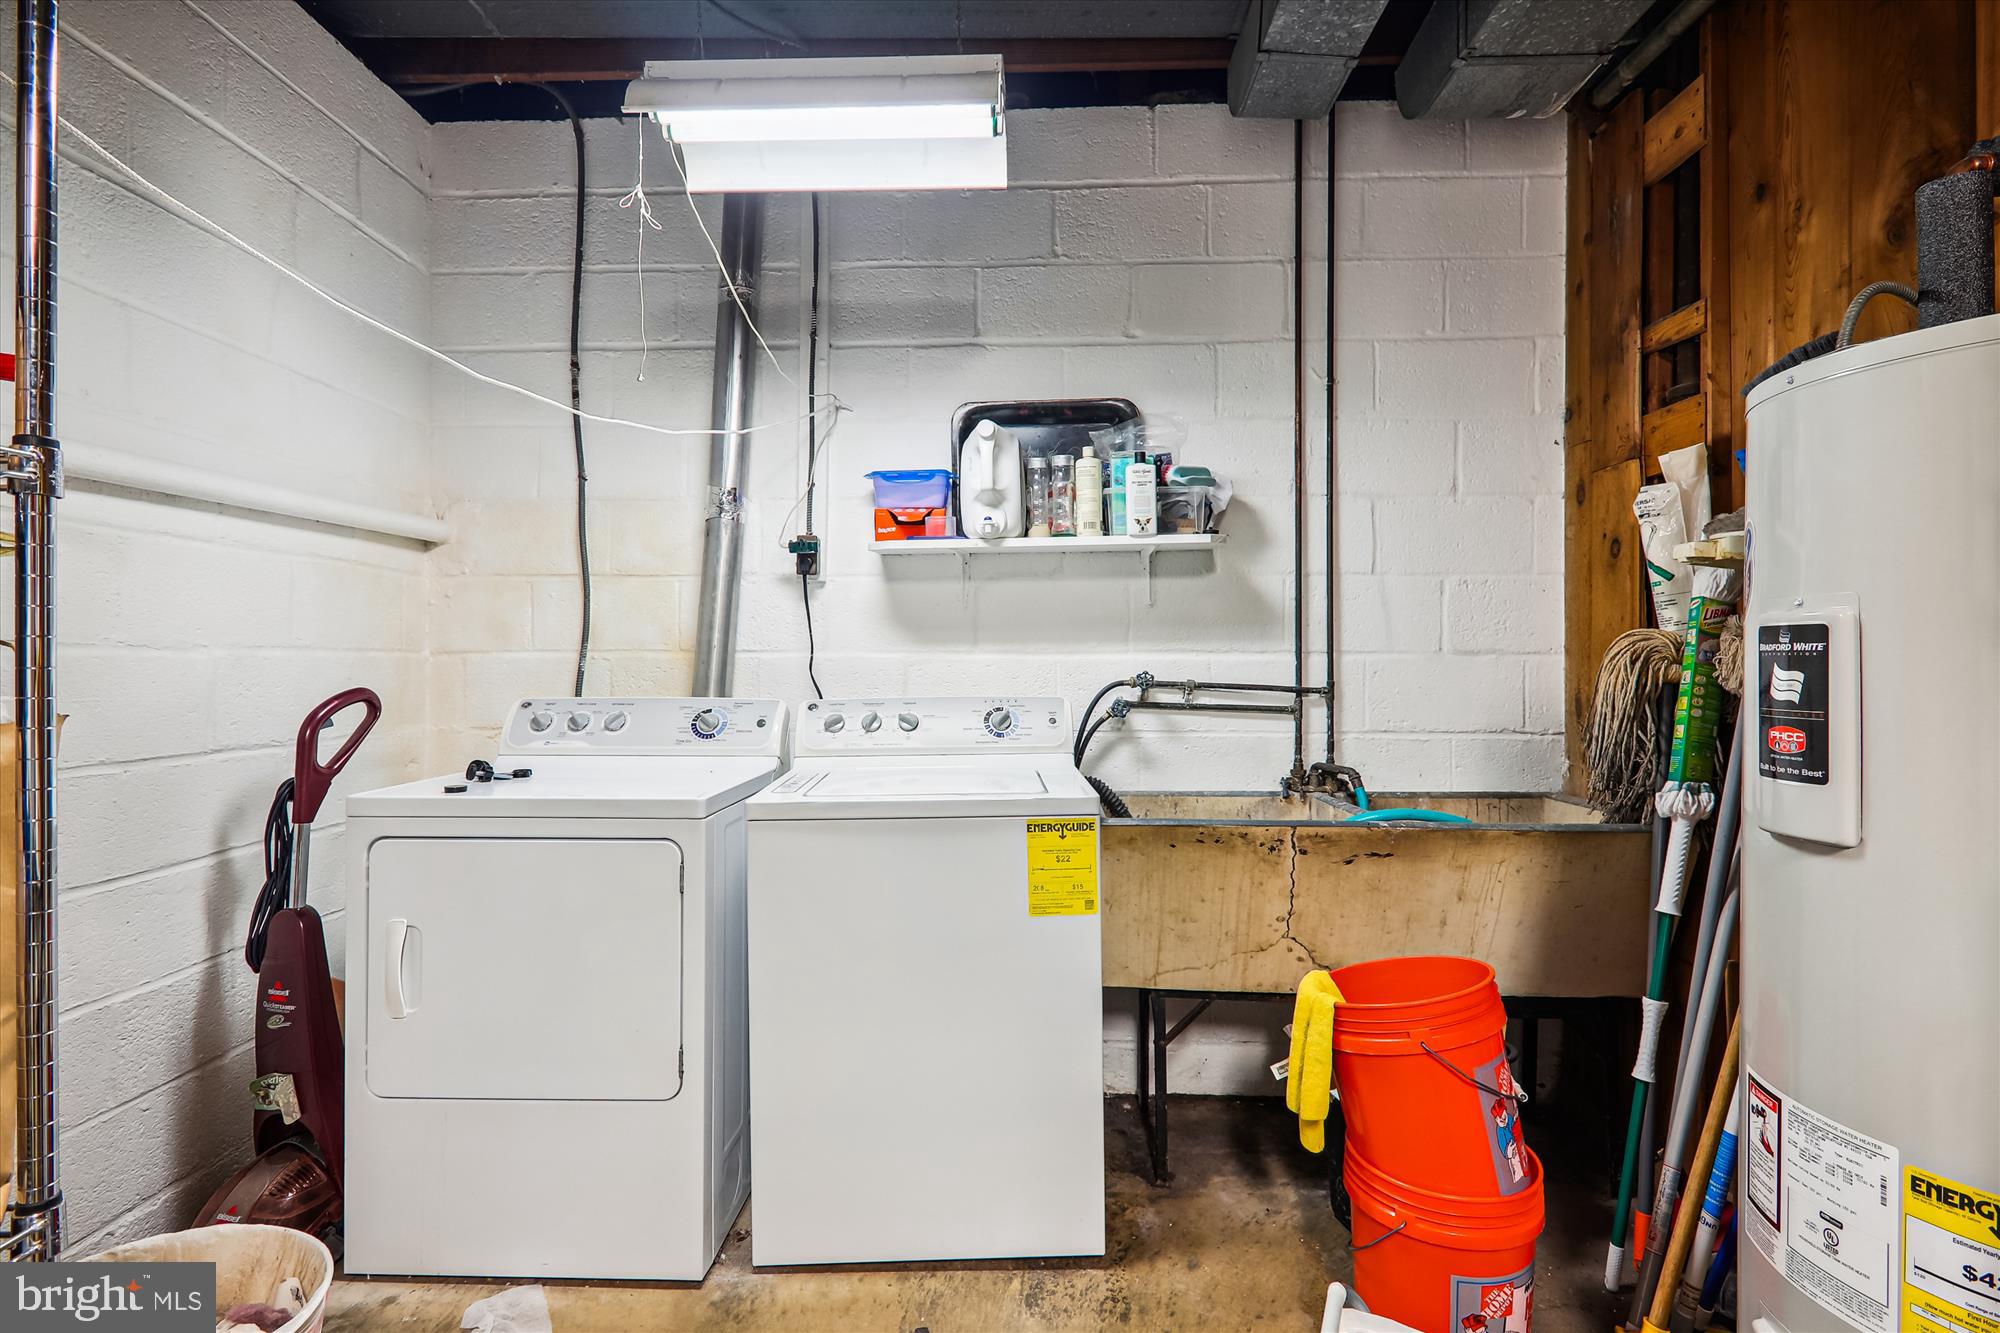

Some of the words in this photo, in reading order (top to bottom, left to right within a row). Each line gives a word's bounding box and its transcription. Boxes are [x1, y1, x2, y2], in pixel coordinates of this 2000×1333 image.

[1760, 643, 1791, 652] BRADFORD
[1793, 643, 1824, 651] WHITE
[1770, 731, 1803, 742] PHCC
[1787, 767, 1799, 775] the
[1801, 769, 1823, 778] Best
[1026, 822, 1096, 833] ENERGYGUIDE
[1055, 855, 1071, 863] $22
[1840, 1129, 1858, 1141] WATER
[1859, 1137, 1882, 1151] HEATER
[1952, 1237, 1982, 1253] Estimated
[1962, 1264, 2000, 1291] $4
[1480, 1284, 1514, 1319] HOME
[1484, 1288, 1500, 1303] THE
[1493, 1295, 1513, 1319] DEPOT
[1968, 1312, 1982, 1323] First
[1983, 1318, 2000, 1329] Hour
